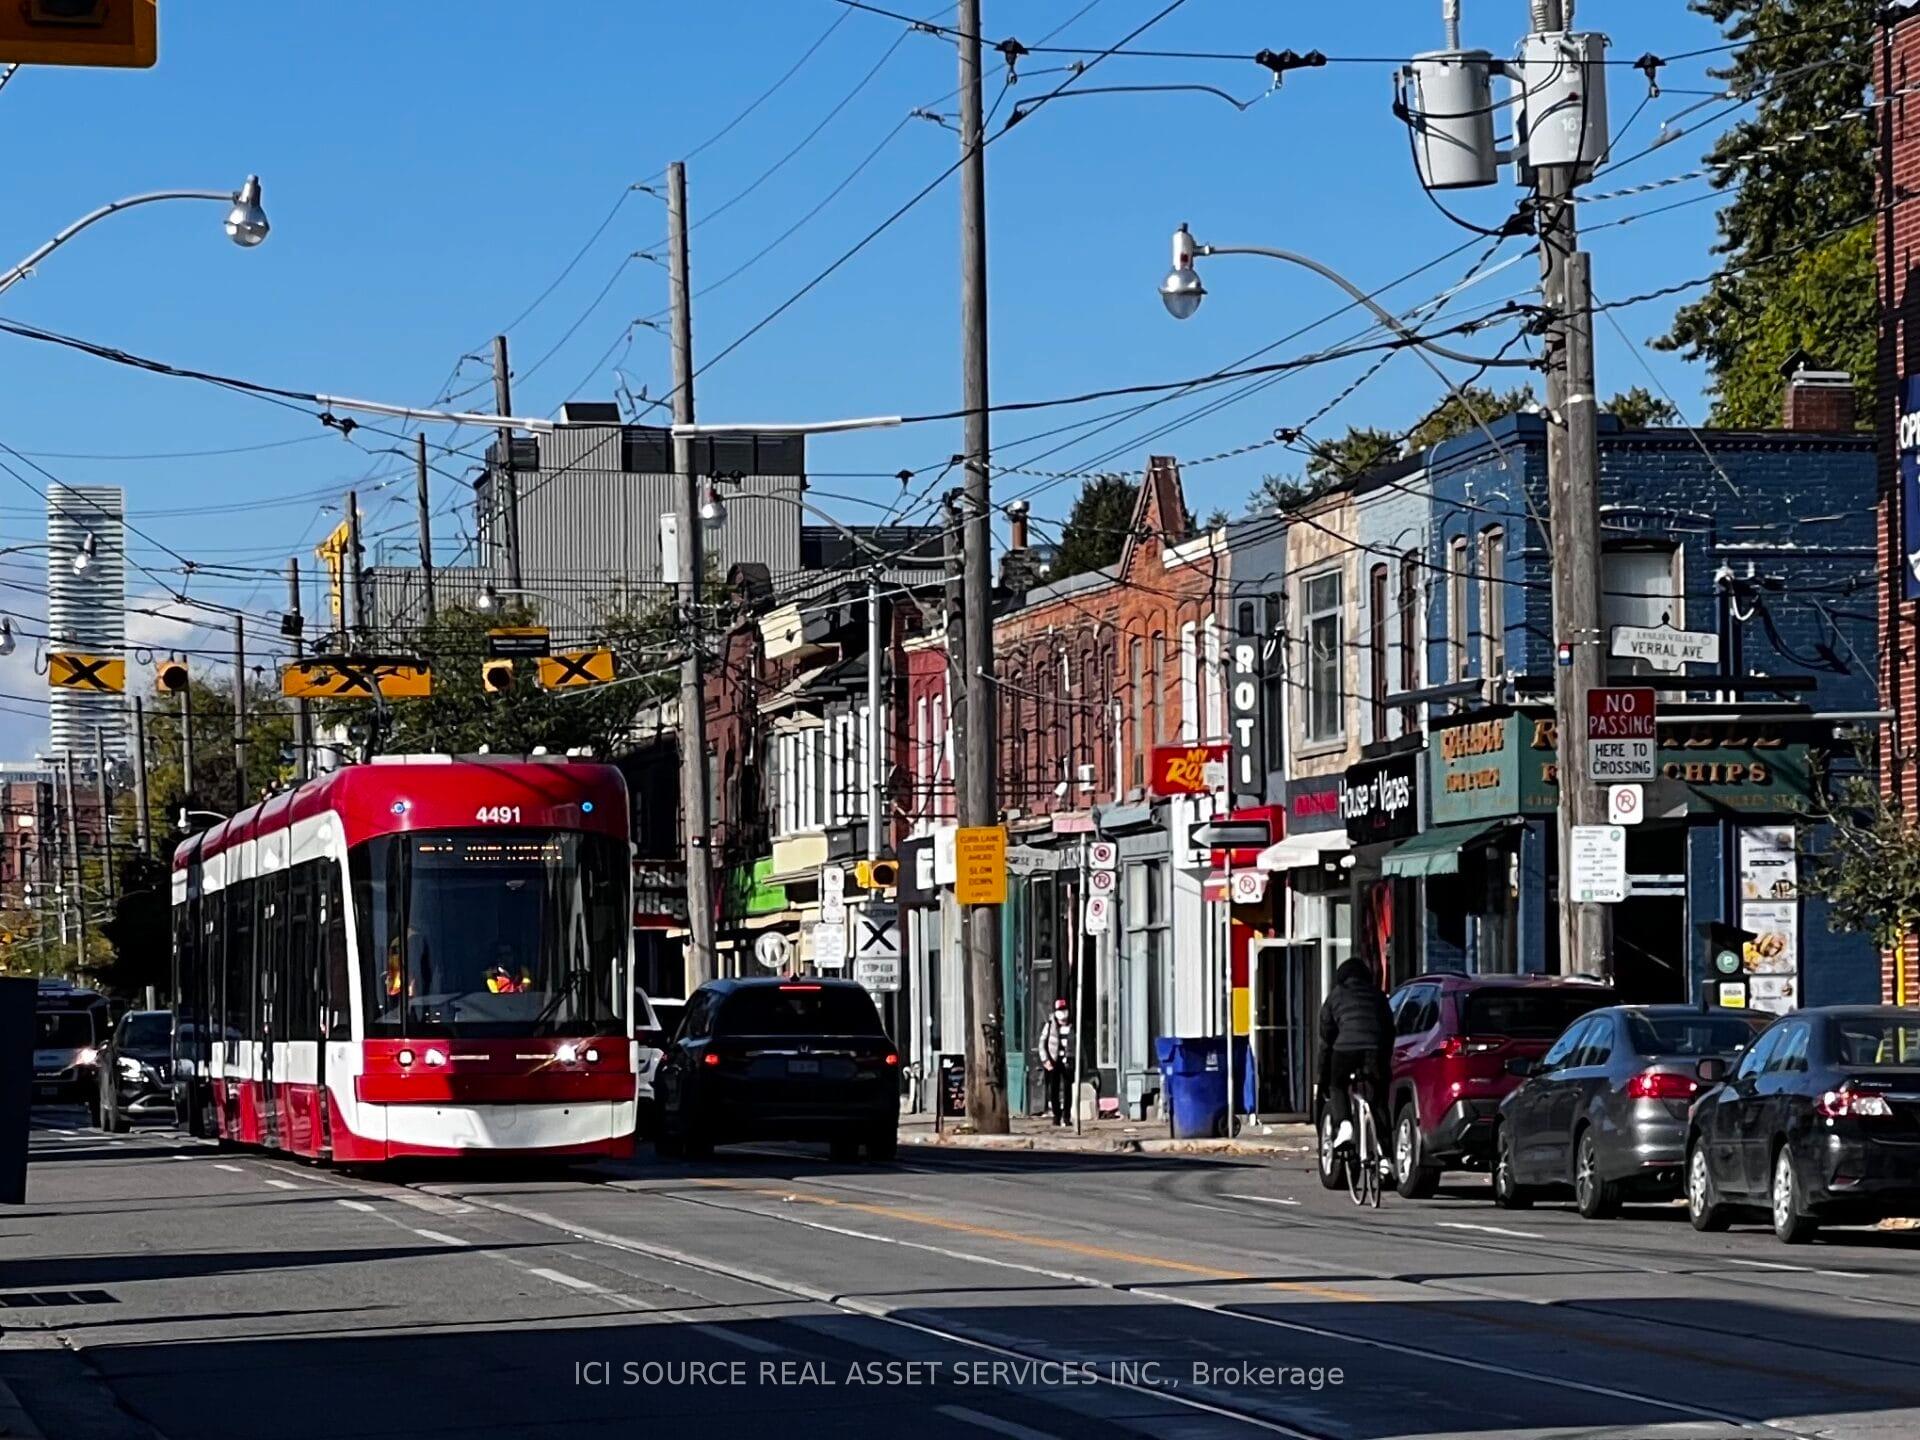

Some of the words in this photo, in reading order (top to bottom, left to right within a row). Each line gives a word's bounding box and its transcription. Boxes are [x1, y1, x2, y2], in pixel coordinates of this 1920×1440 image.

[1631, 641, 1677, 657] VERRAL
[1682, 646, 1703, 659] AVE
[1606, 693, 1636, 713] NO
[1234, 644, 1255, 784] ROTI
[1589, 715, 1653, 735] PASSING
[1595, 743, 1625, 757] HERE
[1633, 743, 1648, 756] TO
[1592, 760, 1651, 775] CROSSING
[1663, 761, 1767, 785] CHIPS
[1339, 778, 1369, 820] House
[1379, 769, 1410, 820] Vapes
[475, 806, 521, 823] 4491
[1005, 855, 1030, 866] ORSE
[1035, 857, 1044, 866] ST
